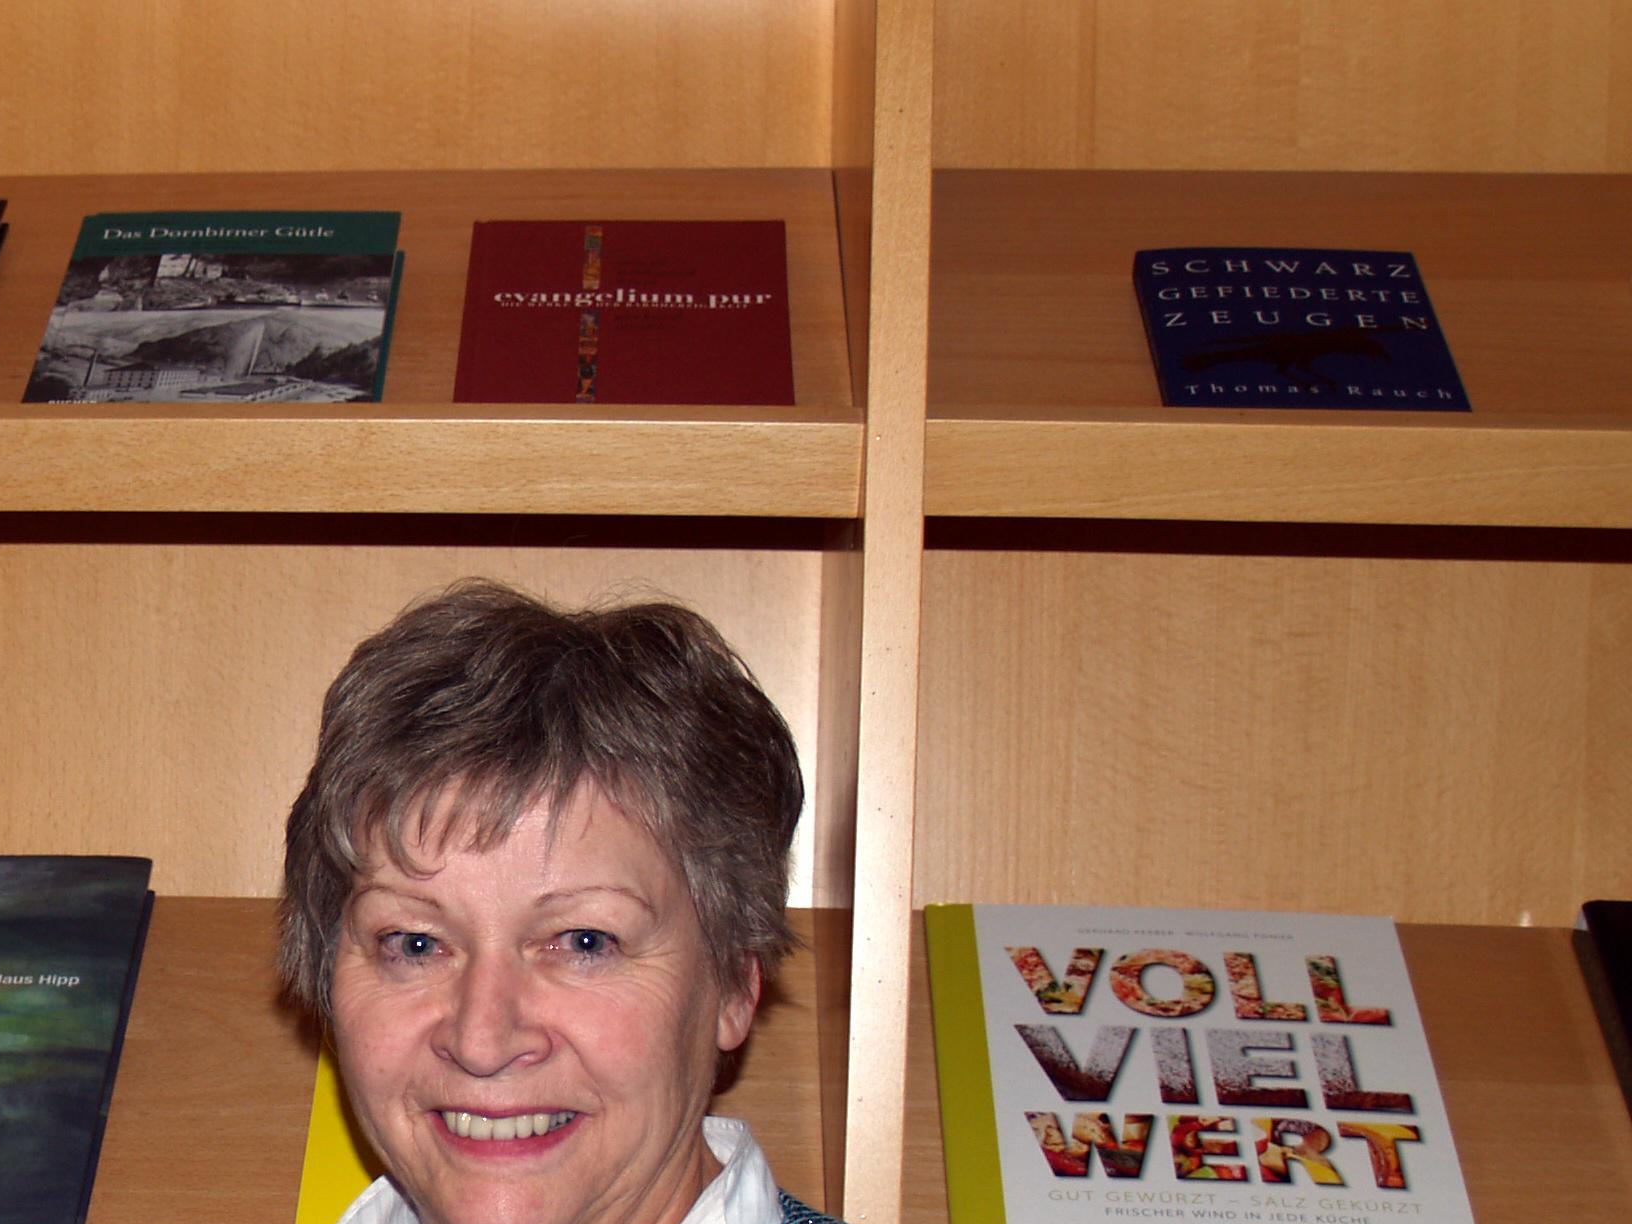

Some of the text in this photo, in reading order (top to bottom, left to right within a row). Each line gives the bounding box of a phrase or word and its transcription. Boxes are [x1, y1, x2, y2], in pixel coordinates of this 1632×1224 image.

[103, 225, 335, 240] Das Dornbirner Gütle
[1151, 259, 1411, 278] SCHWARZ
[494, 288, 772, 309] evangelium pur
[1158, 285, 1421, 305] GEFIEDERTE
[1165, 311, 1429, 331] ZEUGEN
[1185, 384, 1453, 400] Thomas Rauch
[38, 974, 80, 987] Hipp
[1003, 945, 1394, 1027] VOLL
[1013, 1022, 1417, 1114] VIEL
[1023, 1110, 1424, 1190] WERT
[1048, 1189, 1095, 1202] GUT
[1105, 1189, 1216, 1206] GEWÜRZT
[1250, 1194, 1308, 1209] SALZ
[1318, 1197, 1424, 1216] GEKÜRZT
[1105, 1208, 1186, 1219] FRISCHER
[1192, 1210, 1237, 1221] WIND
[1244, 1212, 1261, 1221] IN
[1268, 1212, 1308, 1223] JEDE
